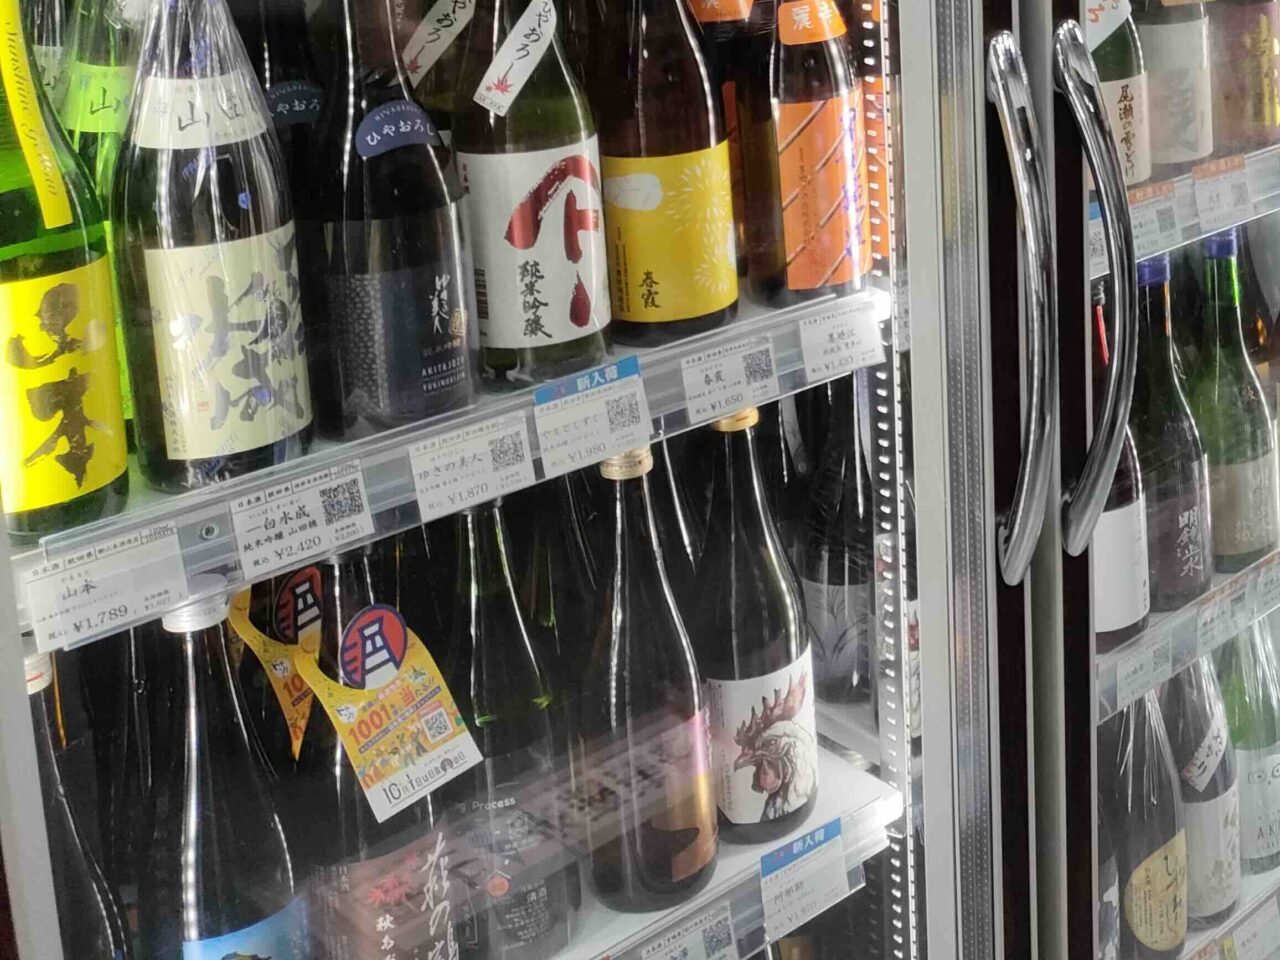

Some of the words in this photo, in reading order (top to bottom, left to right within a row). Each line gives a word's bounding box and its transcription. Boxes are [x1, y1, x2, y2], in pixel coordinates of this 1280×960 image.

[365, 119, 435, 146] ひやおろし
[518, 260, 553, 339] 純米吟醸
[638, 269, 662, 309] 春霞
[568, 442, 607, 462] ¥1,980
[447, 482, 489, 505] ¥1,870
[245, 504, 311, 533] 一白水成
[275, 535, 322, 560] ¥2,420
[62, 578, 97, 602] 山本
[72, 604, 129, 633] ¥1,789
[471, 796, 516, 810] Process
